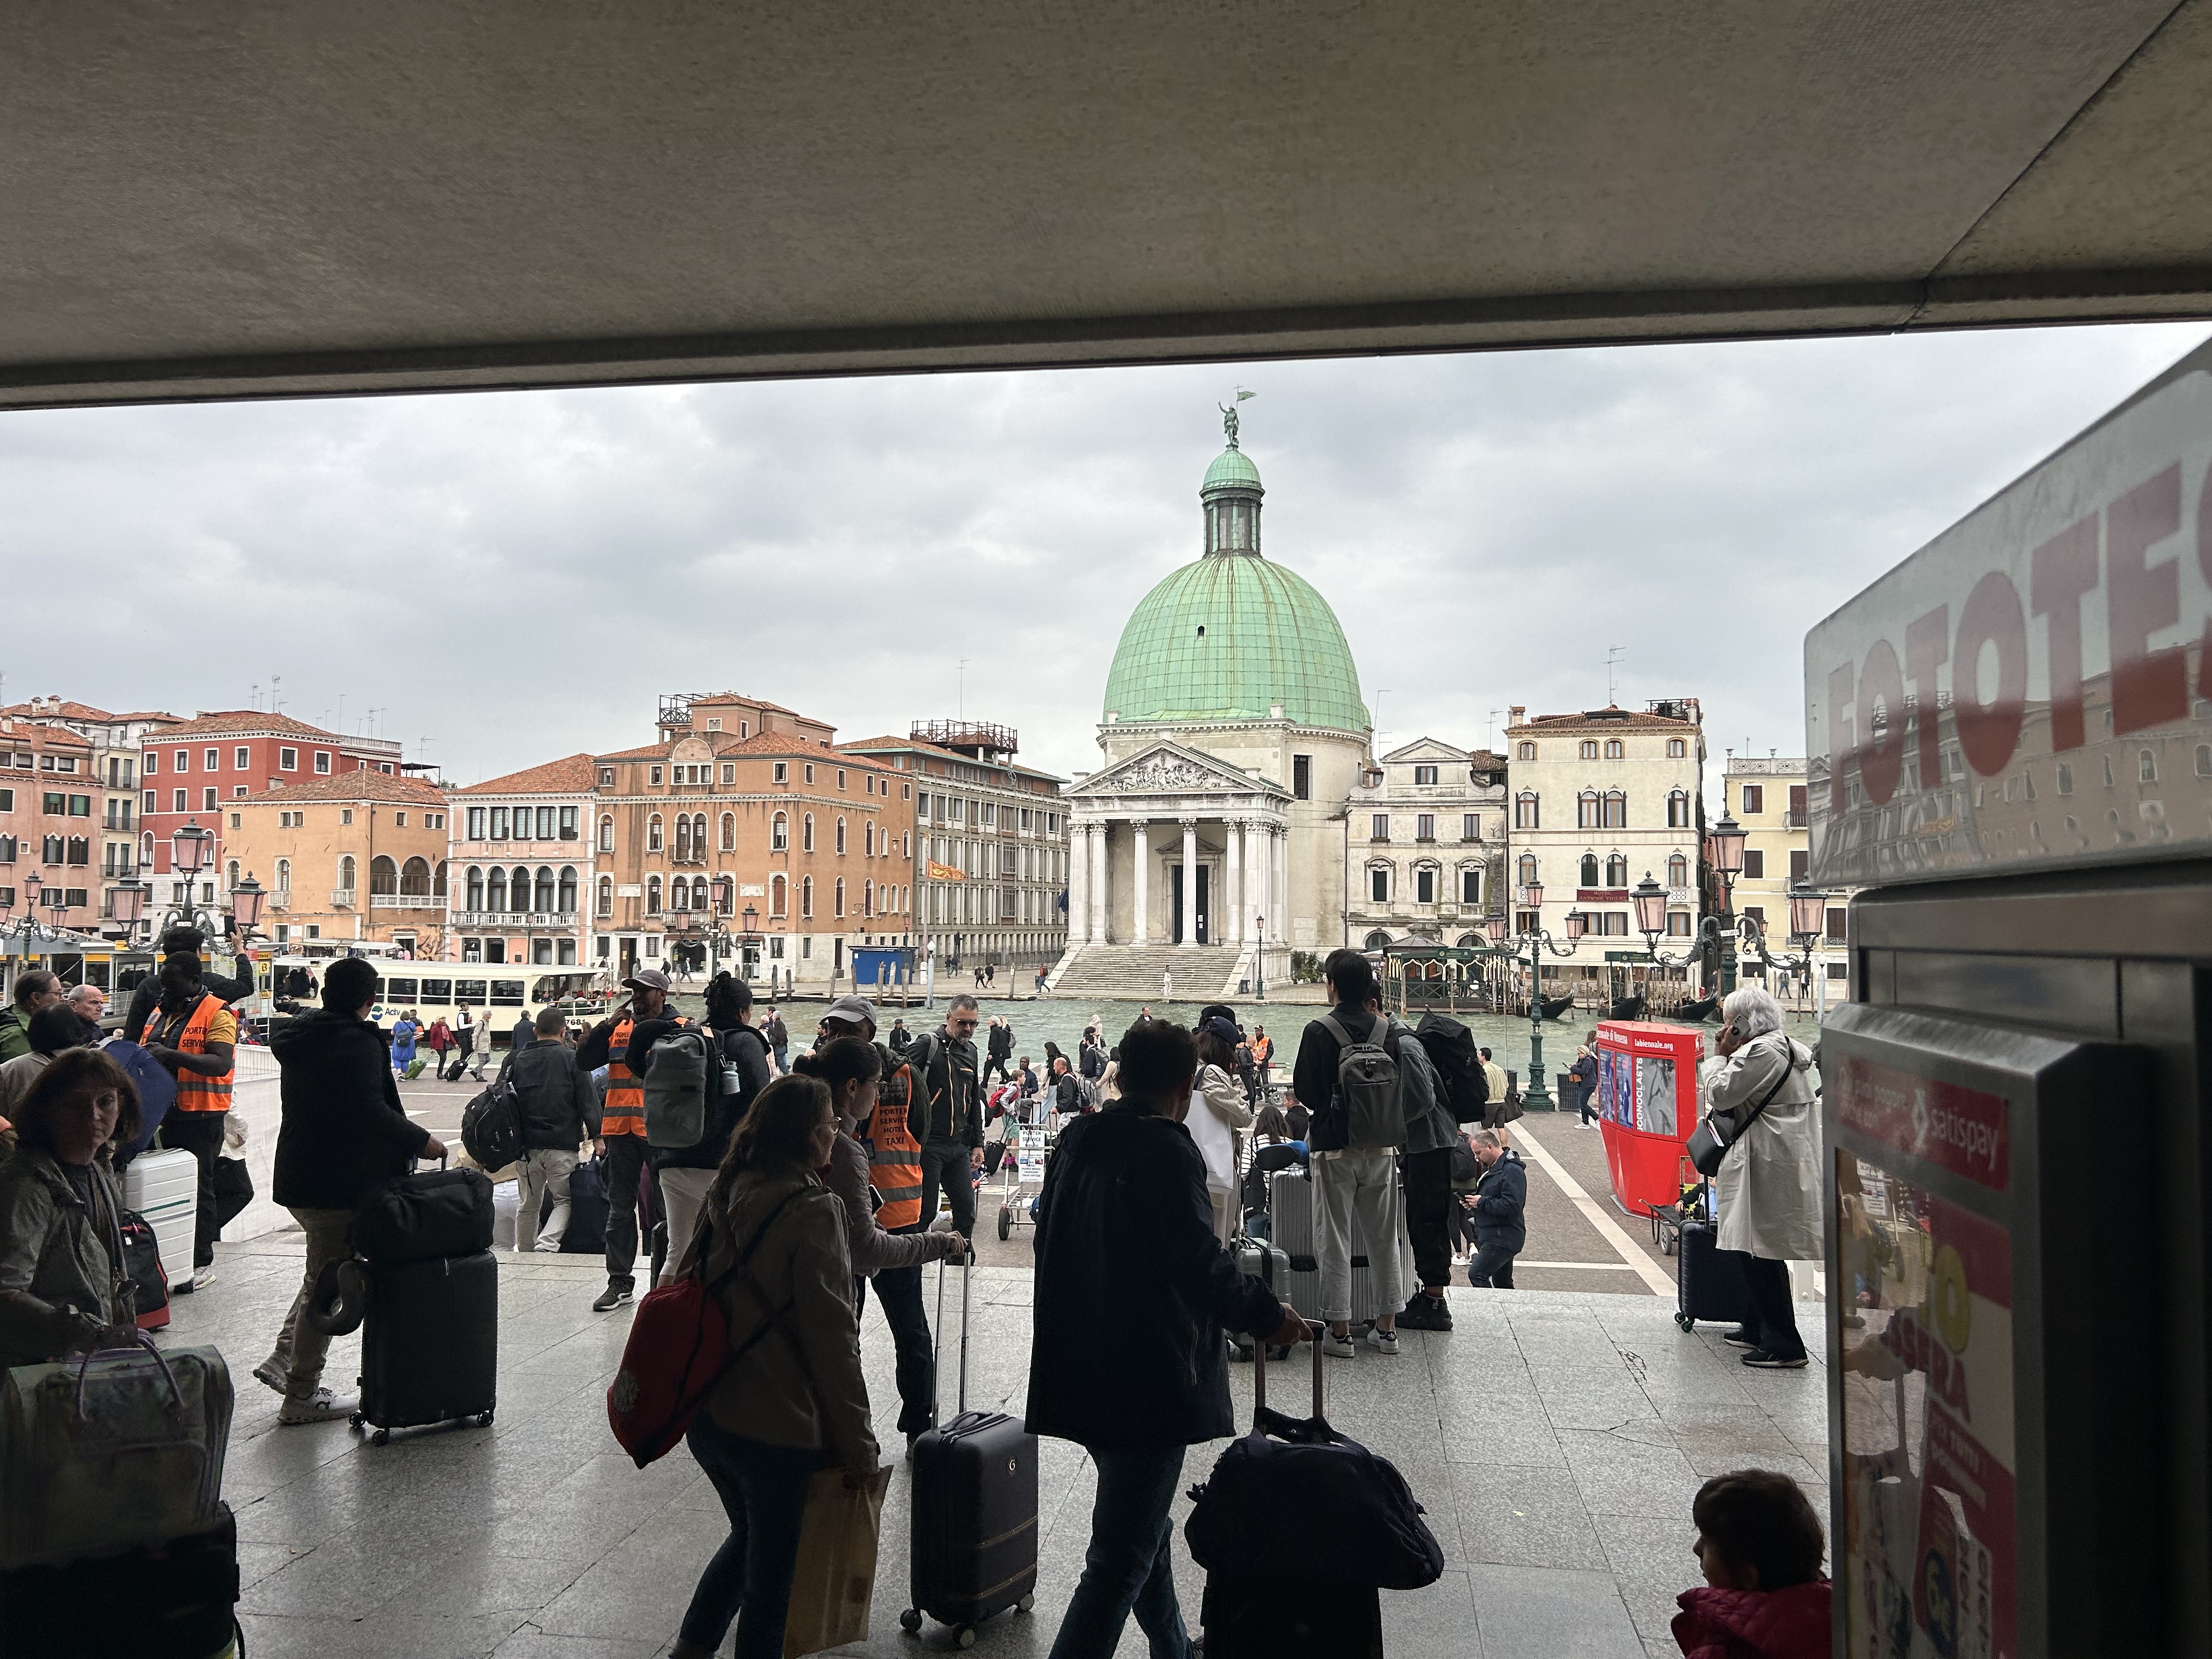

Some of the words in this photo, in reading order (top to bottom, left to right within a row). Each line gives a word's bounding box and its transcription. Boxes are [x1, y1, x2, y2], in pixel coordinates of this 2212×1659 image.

[1828, 458, 2212, 815] FOTOTE
[385, 1007, 400, 1015] Actv
[184, 1026, 207, 1035] PORTE
[182, 1039, 205, 1048] SERVIC
[1634, 1038, 1673, 1052] labiennale.org
[884, 1136, 905, 1146] TAXI
[1931, 1106, 1999, 1171] satispay
